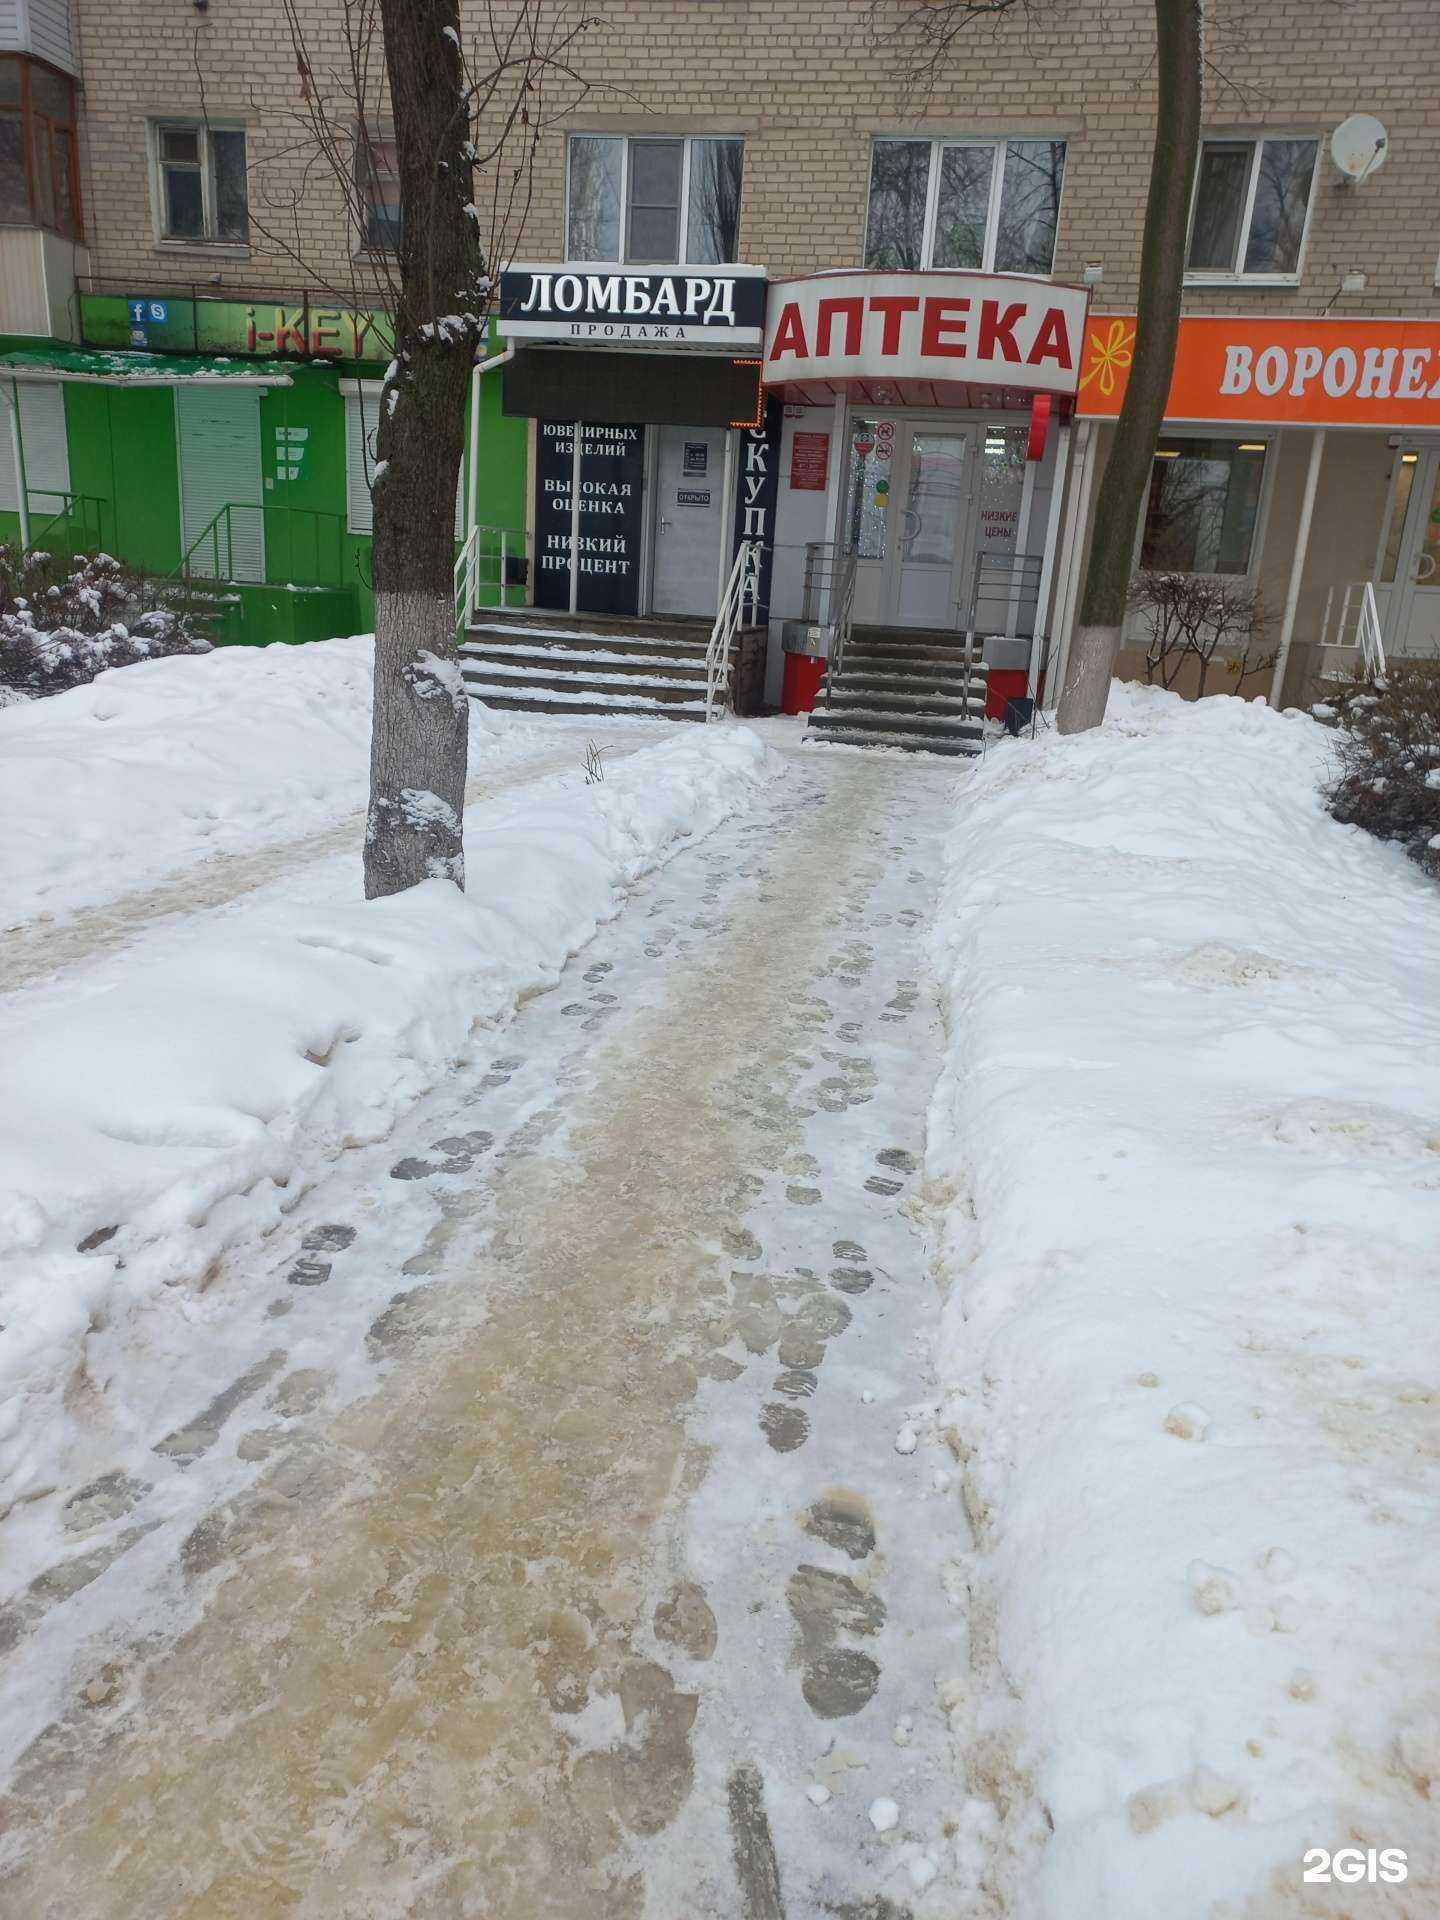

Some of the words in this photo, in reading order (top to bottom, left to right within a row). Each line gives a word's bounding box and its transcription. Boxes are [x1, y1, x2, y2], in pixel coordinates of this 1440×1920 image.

[521, 275, 736, 326] ЛОМБАРД
[246, 306, 374, 357] i-KEY
[571, 324, 686, 339] ПРОДАЖА
[769, 296, 1072, 369] АПТЕКА
[1219, 345, 1440, 399] ВОРОНЕ
[555, 442, 626, 457] ИЗЕЛИЙ
[544, 479, 632, 496] ВЫОКАЯ
